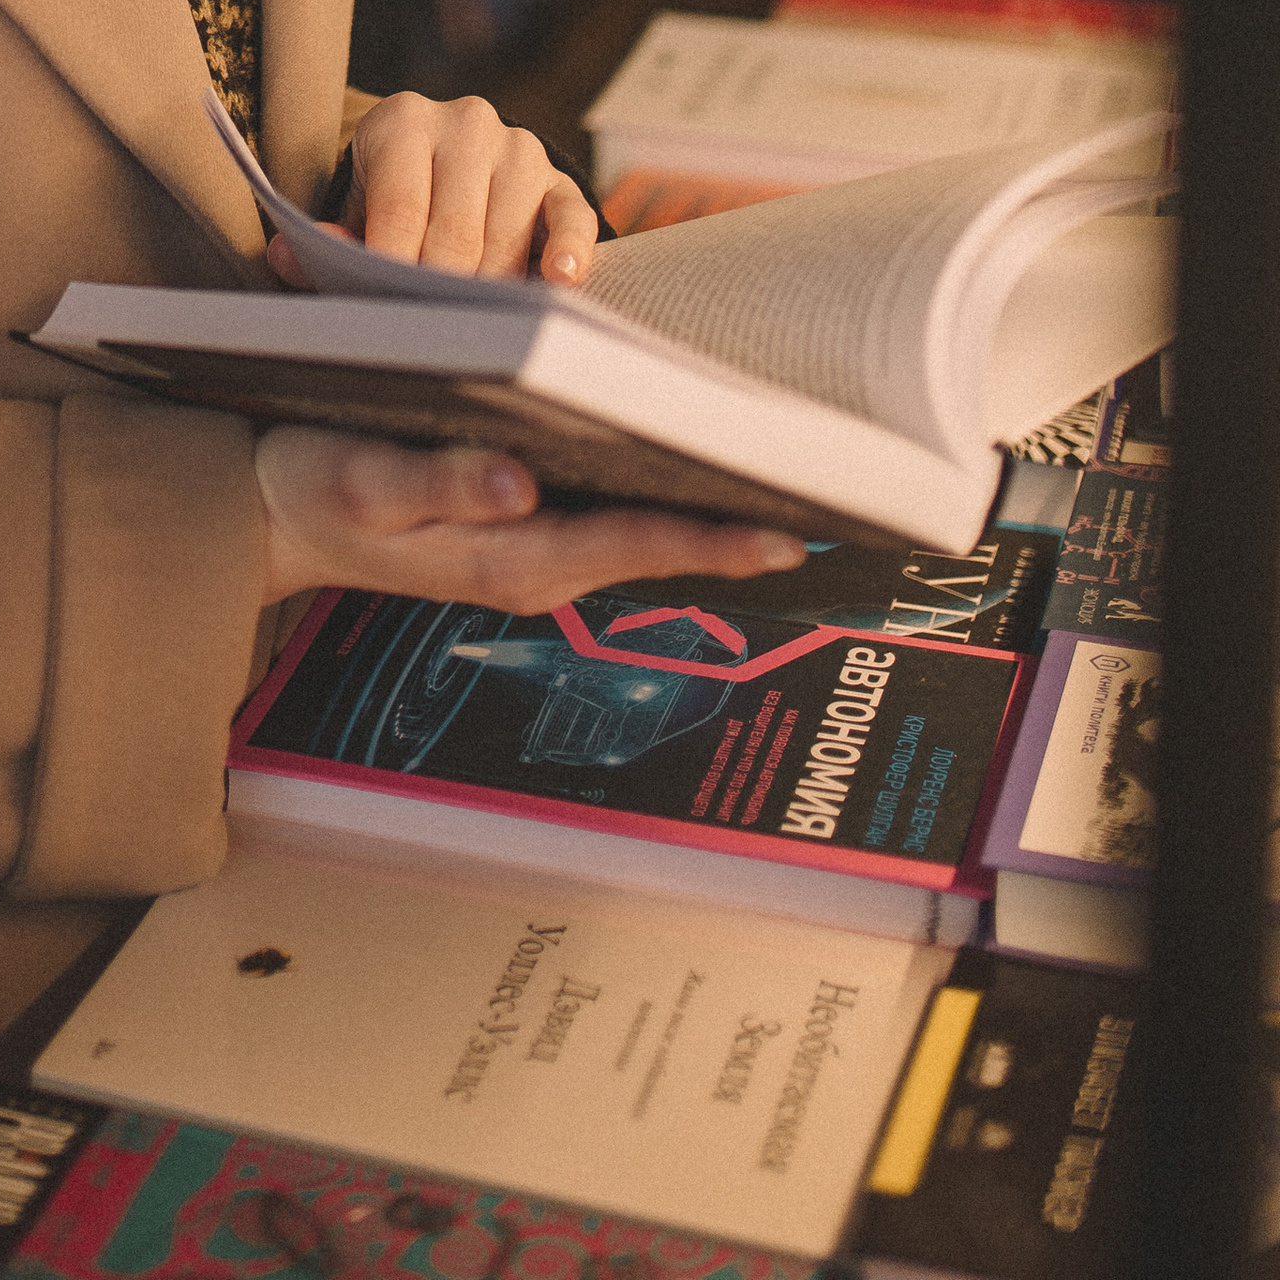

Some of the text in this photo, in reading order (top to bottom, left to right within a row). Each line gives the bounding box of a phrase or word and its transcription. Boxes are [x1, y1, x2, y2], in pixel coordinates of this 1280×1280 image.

[881, 543, 1000, 643] ЛУН
[747, 706, 775, 748] ВОДИТЕЛЯ
[764, 690, 782, 706] БЕЗ
[780, 646, 896, 839] автономия
[1080, 675, 1113, 754] книги политеха
[691, 719, 744, 817] ДЛЯ НАШЕГО БУДУЩЕГО
[716, 788, 741, 822] ЗНАЧИТ
[730, 772, 747, 788] ЭТО
[737, 756, 754, 772] ЧТО
[741, 709, 799, 825] КАК ПОЯВИЛСЯ АВТОМОБИЛЬ
[864, 715, 926, 846] КРИСТОФЕР ШУЛГАН
[918, 746, 955, 806] ЛОУРЕНС
[903, 807, 936, 853] БЕРНС
[444, 924, 568, 1104] Уоллес-Уэллс
[525, 975, 602, 1064] Дэвид
[713, 1013, 782, 1104] Земля
[758, 979, 860, 1174] Необитаемая
